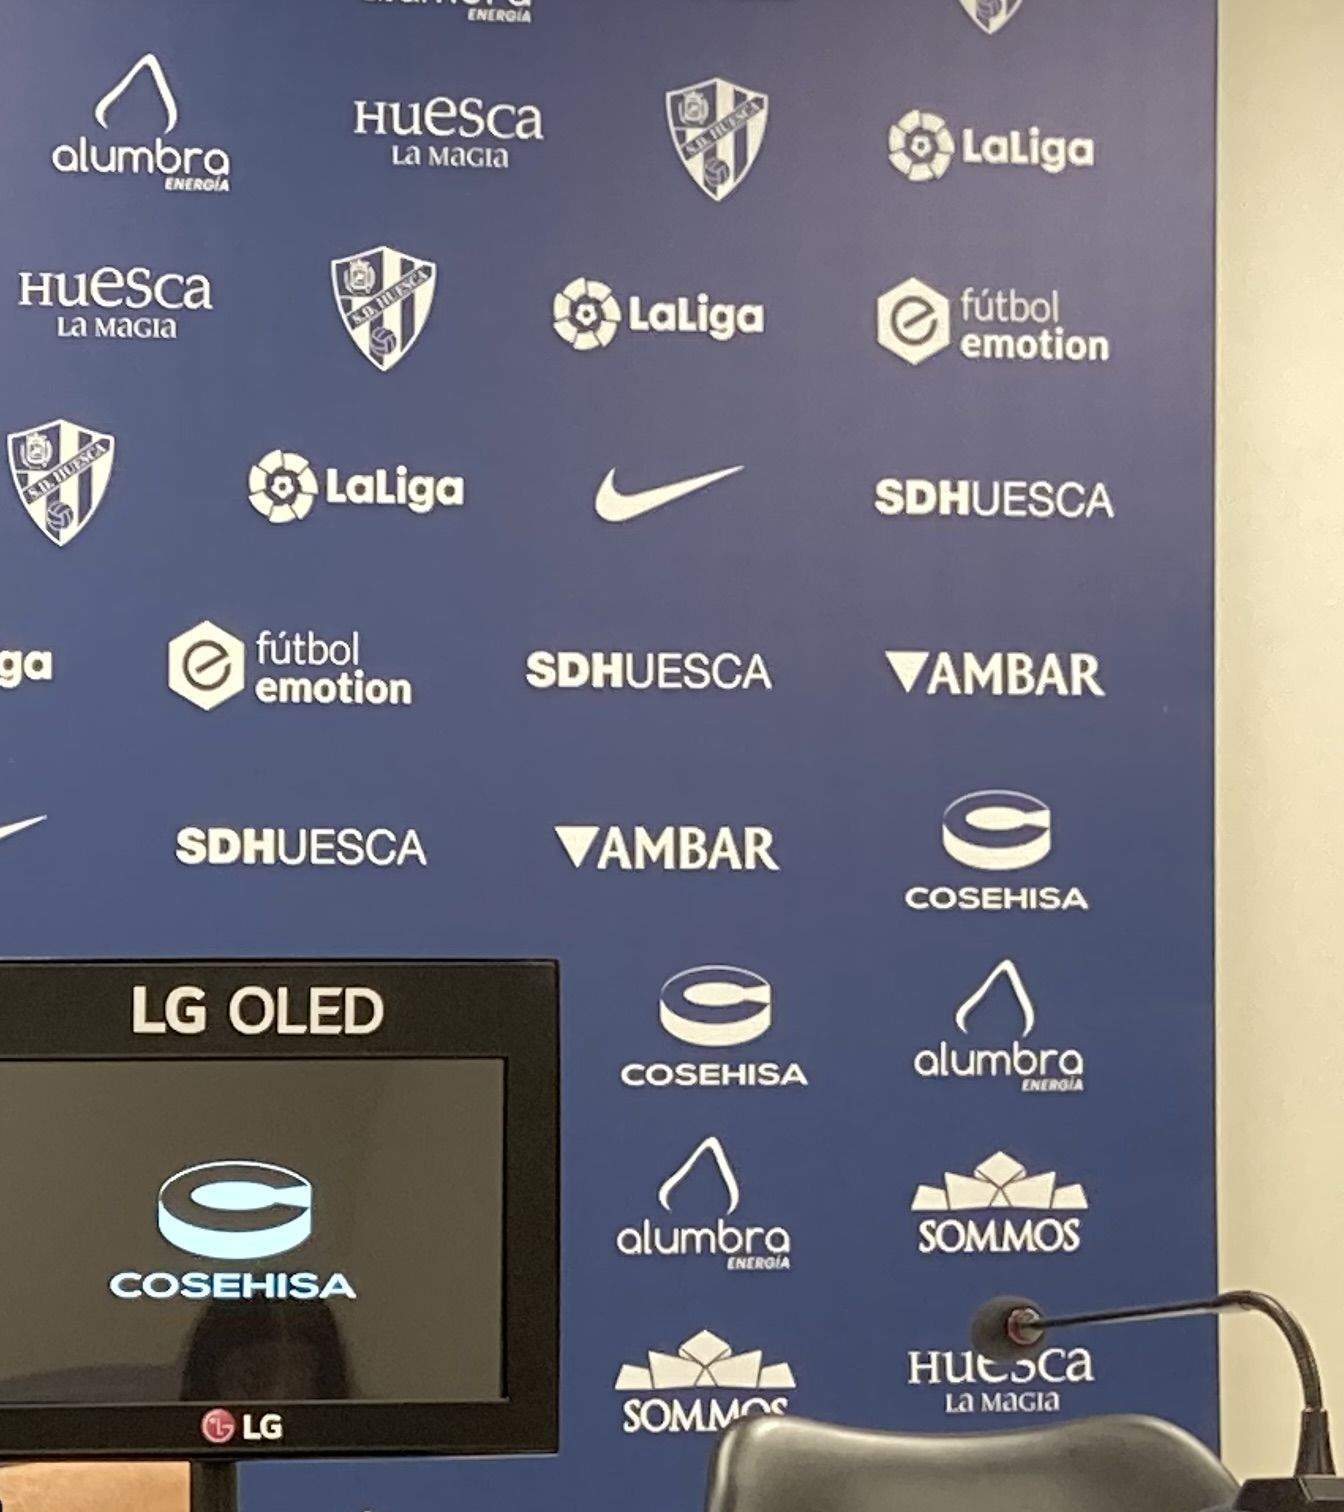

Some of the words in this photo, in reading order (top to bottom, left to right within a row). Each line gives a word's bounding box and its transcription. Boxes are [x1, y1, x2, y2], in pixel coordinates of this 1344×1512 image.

[53, 136, 229, 175] alumbra
[963, 127, 1094, 173] LaLiga
[630, 293, 763, 340] LaLiga
[961, 287, 1058, 322] fútbol
[961, 327, 1109, 360] emotion
[327, 466, 463, 513] LaLiga
[875, 479, 1114, 517] SDHUESCA
[256, 630, 358, 665] fútbol
[256, 669, 411, 704] emotion
[526, 651, 772, 689] SDHUESCA
[927, 652, 1105, 696] AMBAR
[176, 827, 427, 865] SDHUESCA
[598, 826, 779, 870] AMBAR
[906, 887, 1088, 909] COSEHISA
[134, 986, 206, 1033] LG
[230, 986, 383, 1034] OLED
[621, 1063, 808, 1085] COSEHISA
[914, 1041, 1083, 1076] alumbra
[617, 1219, 789, 1254] alumbra
[919, 1218, 1080, 1253] SOMMOS
[110, 1273, 356, 1298] COSEHISA
[244, 1414, 282, 1439] LG
